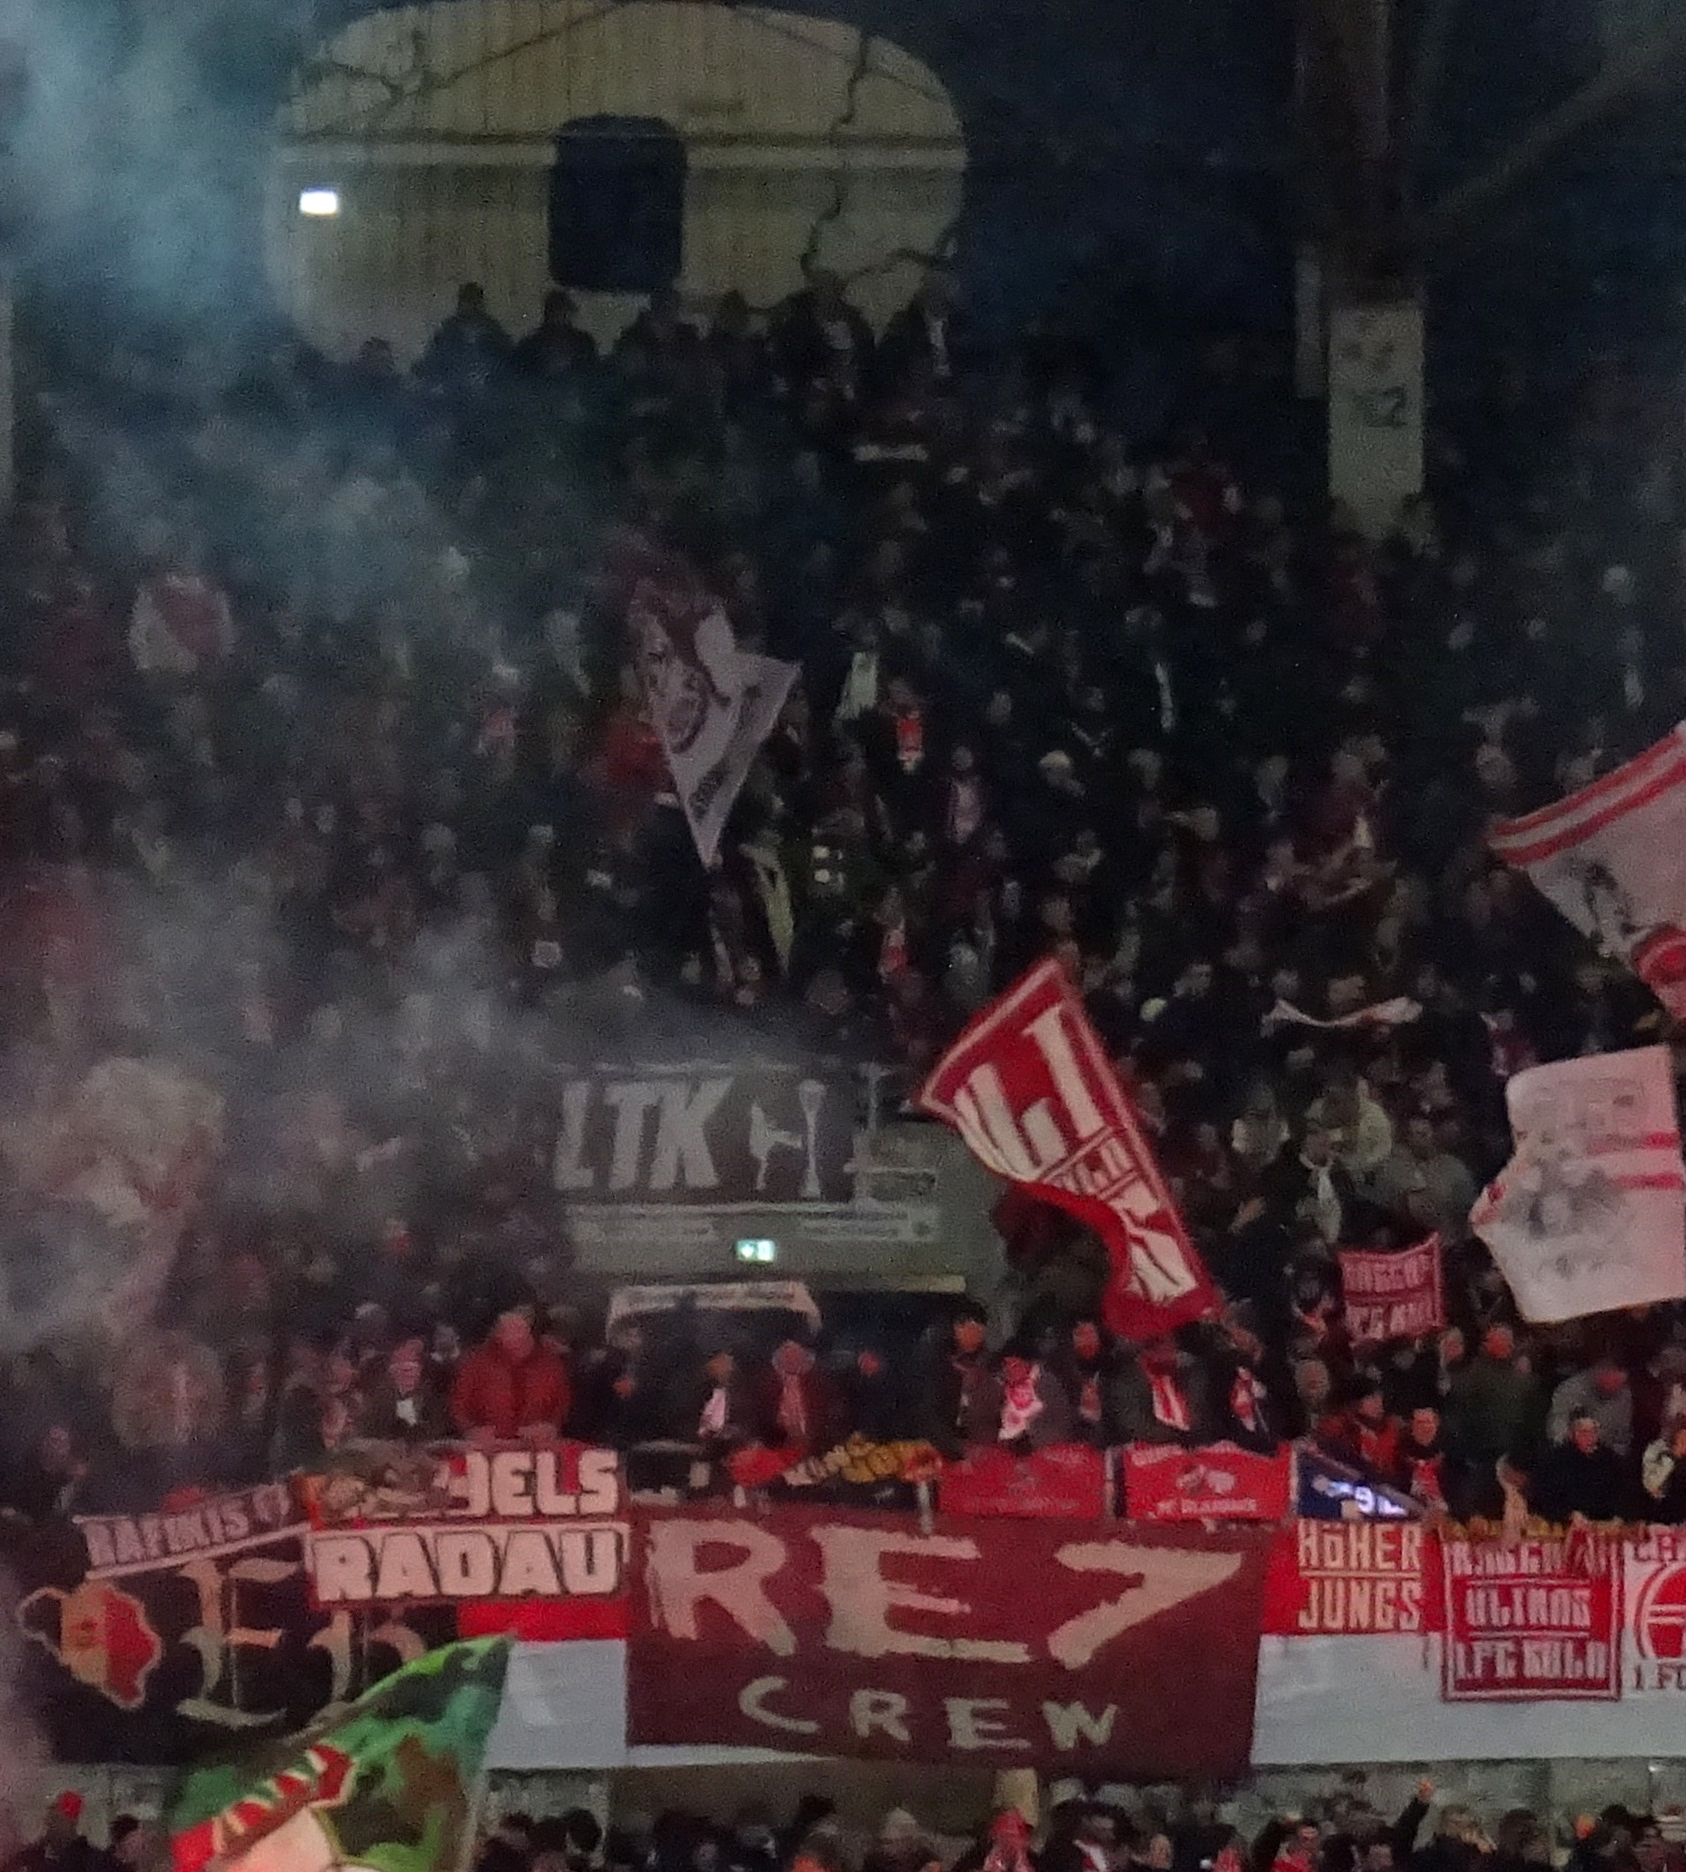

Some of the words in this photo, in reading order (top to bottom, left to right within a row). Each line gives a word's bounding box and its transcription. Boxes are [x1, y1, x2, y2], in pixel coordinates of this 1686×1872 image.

[555, 1078, 735, 1191] LTK
[316, 1532, 617, 1600] RADAU
[646, 1518, 1243, 1670] RE7
[1298, 1579, 1421, 1630] JUNGS
[739, 1675, 1119, 1751] CREW
